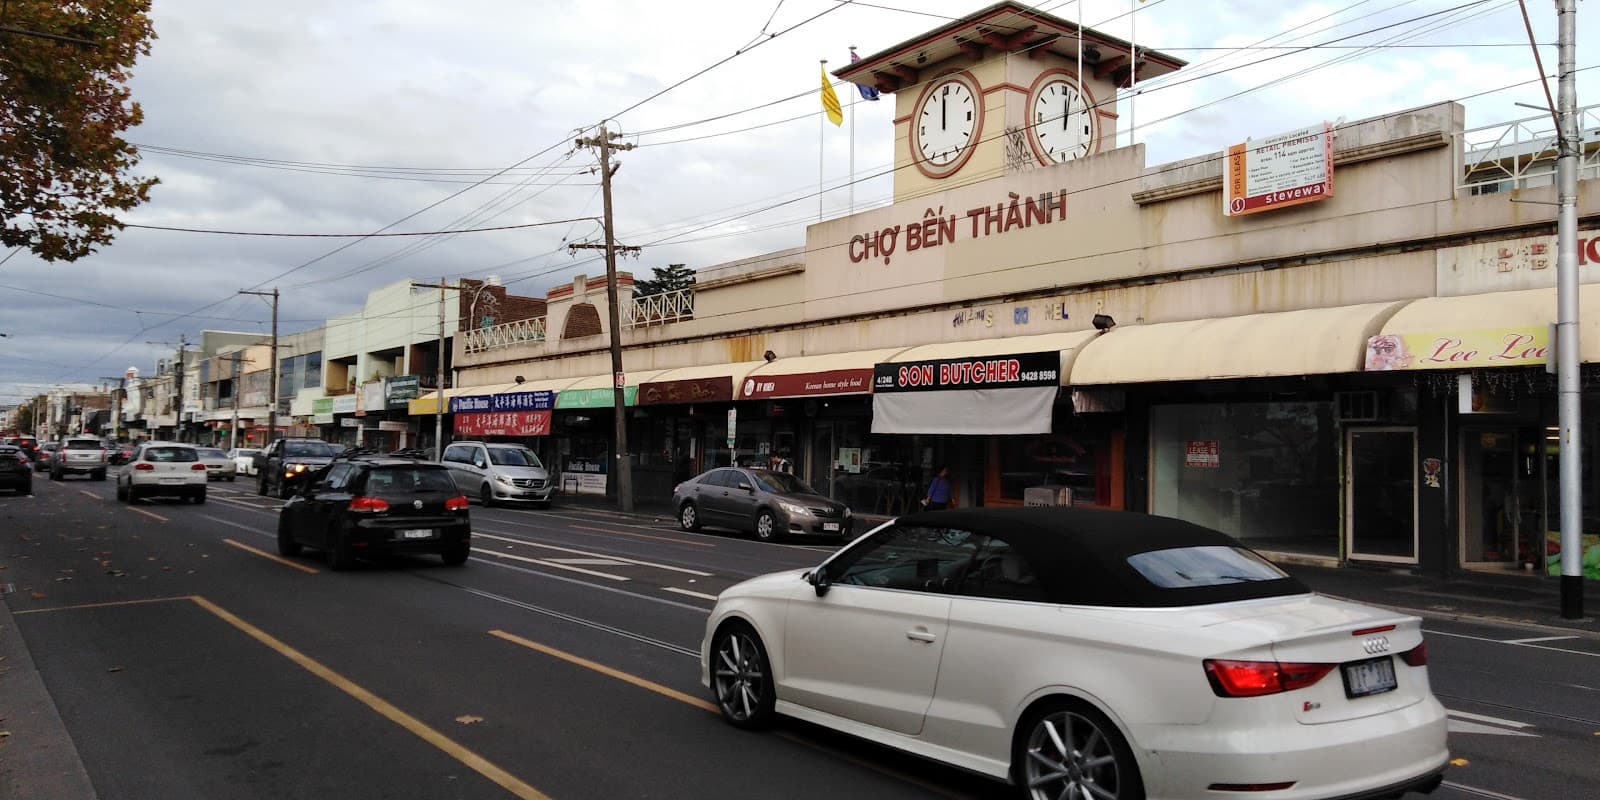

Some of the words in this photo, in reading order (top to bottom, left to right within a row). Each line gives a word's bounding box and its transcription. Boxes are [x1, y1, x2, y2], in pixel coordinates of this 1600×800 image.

[1256, 144, 1280, 155] RETAIL
[1282, 135, 1319, 149] PREMISES
[1274, 150, 1286, 160] 114
[848, 226, 900, 266] CHỢ
[906, 206, 956, 252] BẾN
[967, 189, 1067, 238] THÀNH
[1420, 338, 1480, 364] Lee
[1488, 334, 1548, 360] Lee
[898, 364, 934, 387] SON
[940, 359, 1020, 385] BUTCHER
[1021, 372, 1038, 382] 9428
[1039, 370, 1056, 380] 8598
[823, 380, 836, 388] home
[837, 380, 849, 390] style
[850, 378, 862, 386] food
[458, 398, 474, 410] Pacific
[474, 398, 489, 408] House
